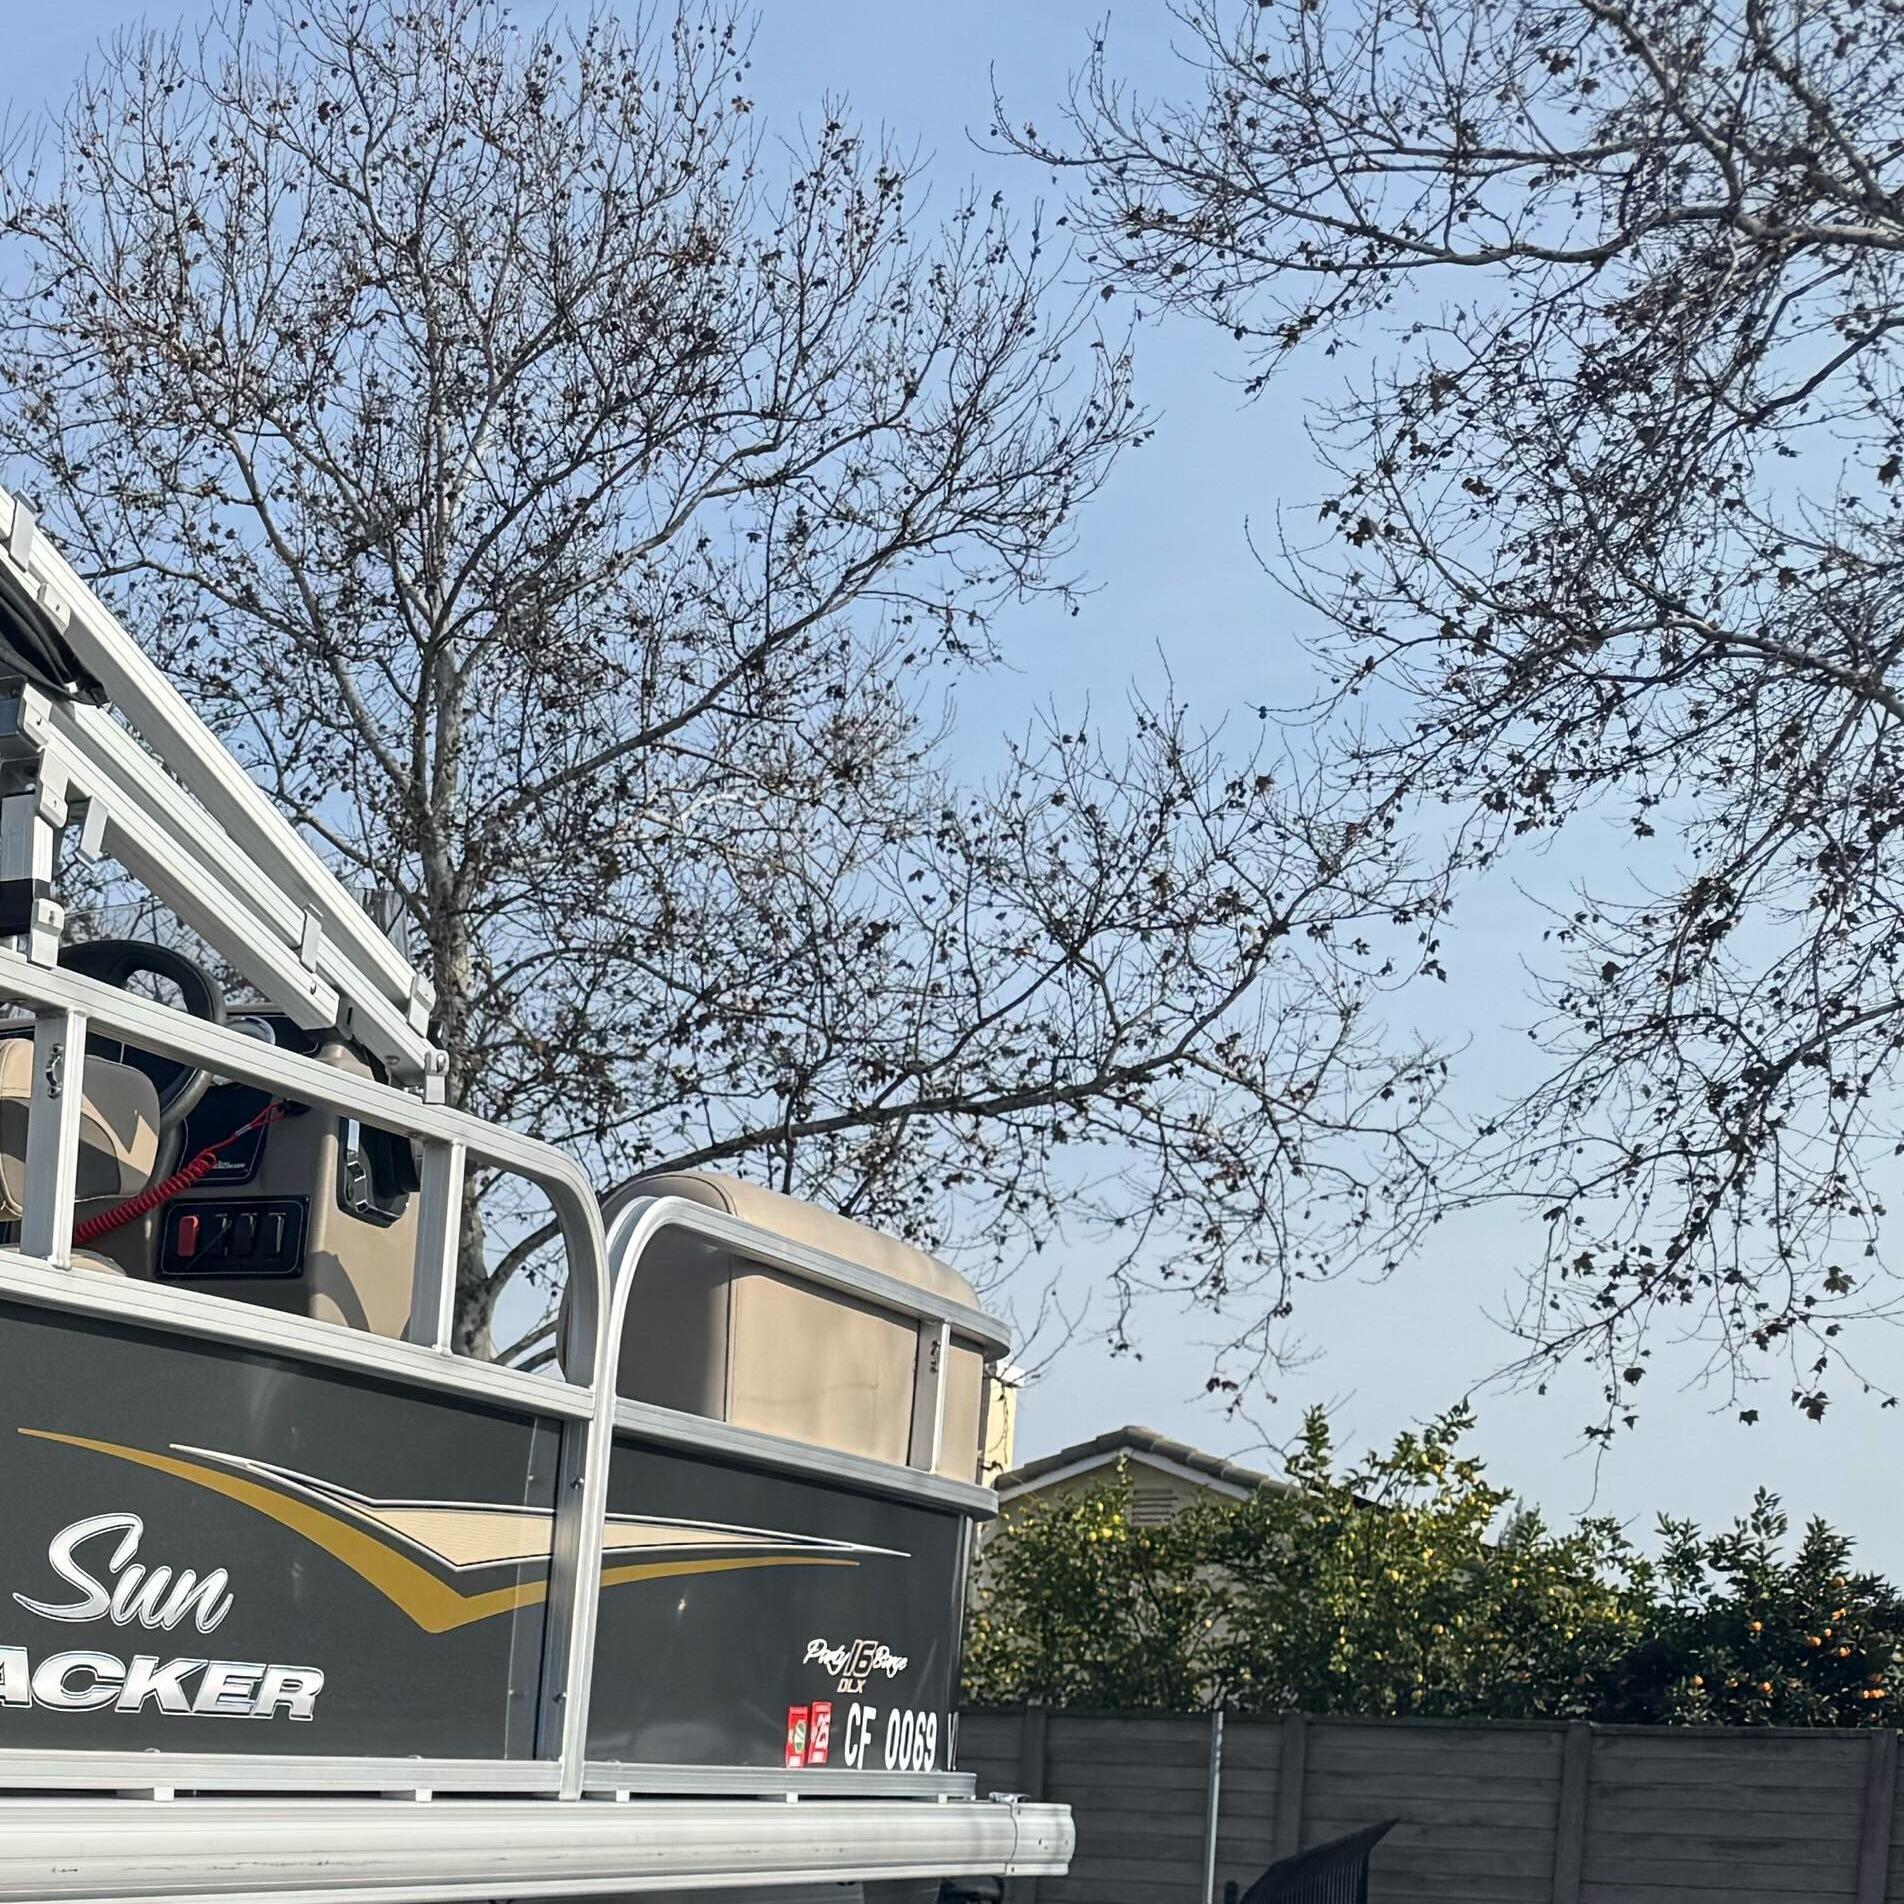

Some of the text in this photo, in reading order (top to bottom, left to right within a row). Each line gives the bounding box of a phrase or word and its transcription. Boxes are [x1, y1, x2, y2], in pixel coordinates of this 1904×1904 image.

[11, 1511, 236, 1636] Sun
[843, 1638, 879, 1678] 16
[844, 1702, 877, 1770] CF
[885, 1707, 938, 1773] 0069
